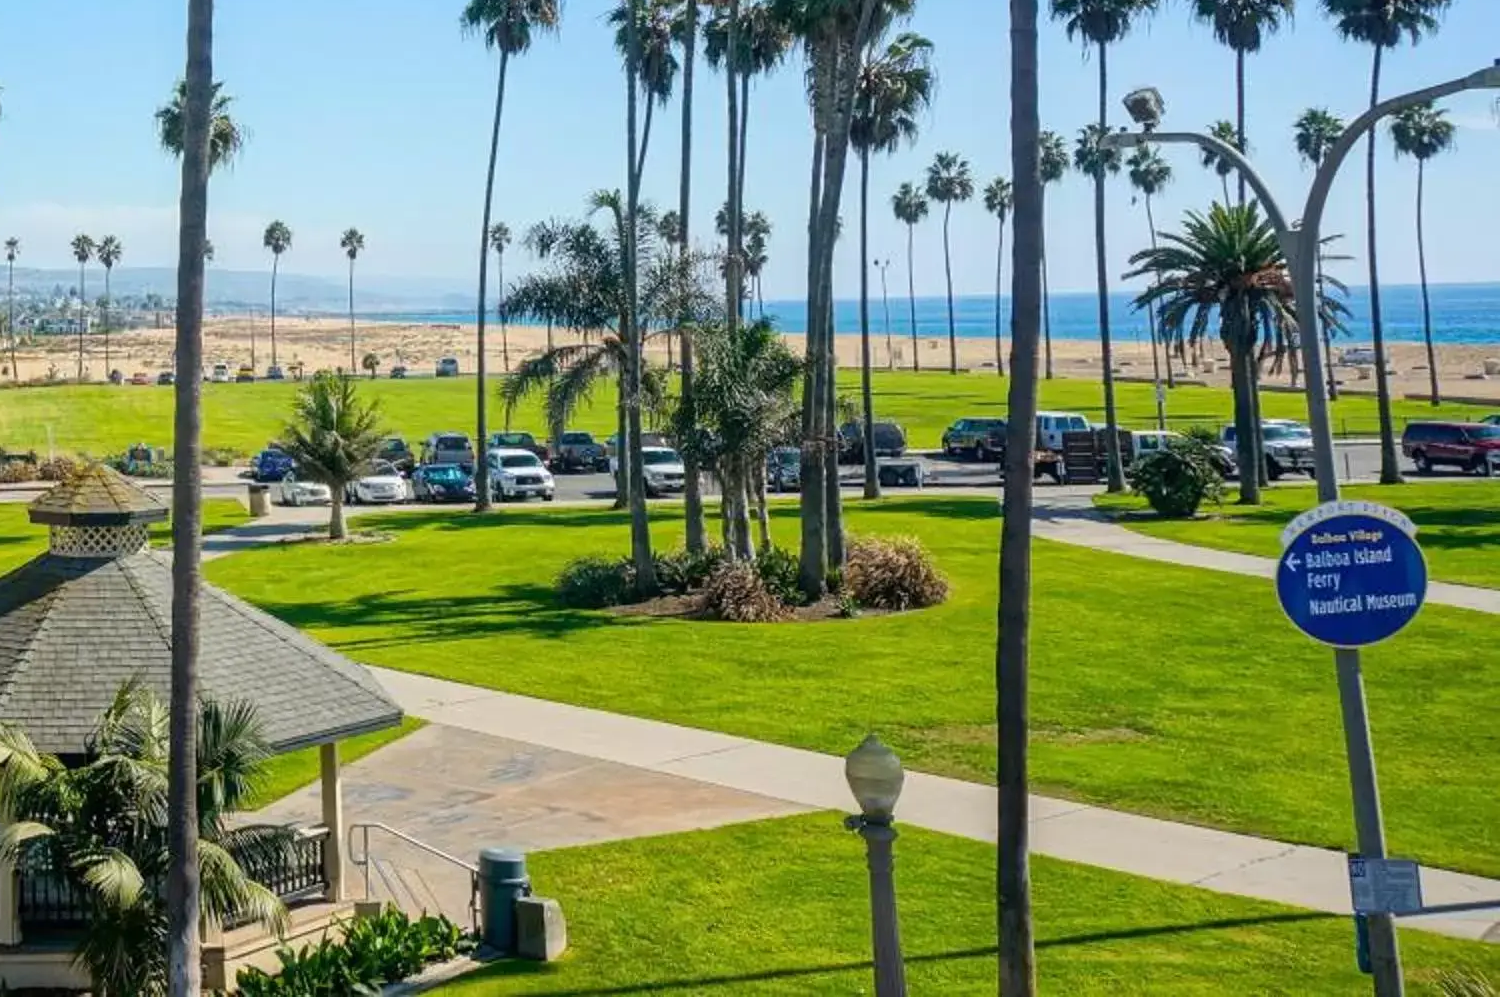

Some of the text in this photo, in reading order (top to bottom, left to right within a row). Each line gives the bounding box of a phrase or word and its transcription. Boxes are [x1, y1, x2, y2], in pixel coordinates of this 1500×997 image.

[1311, 529, 1383, 544] Balboa Village
[1305, 546, 1392, 569] Balboa Island
[1307, 572, 1340, 591] Ferry
[1309, 592, 1417, 616] Nautical Museum
